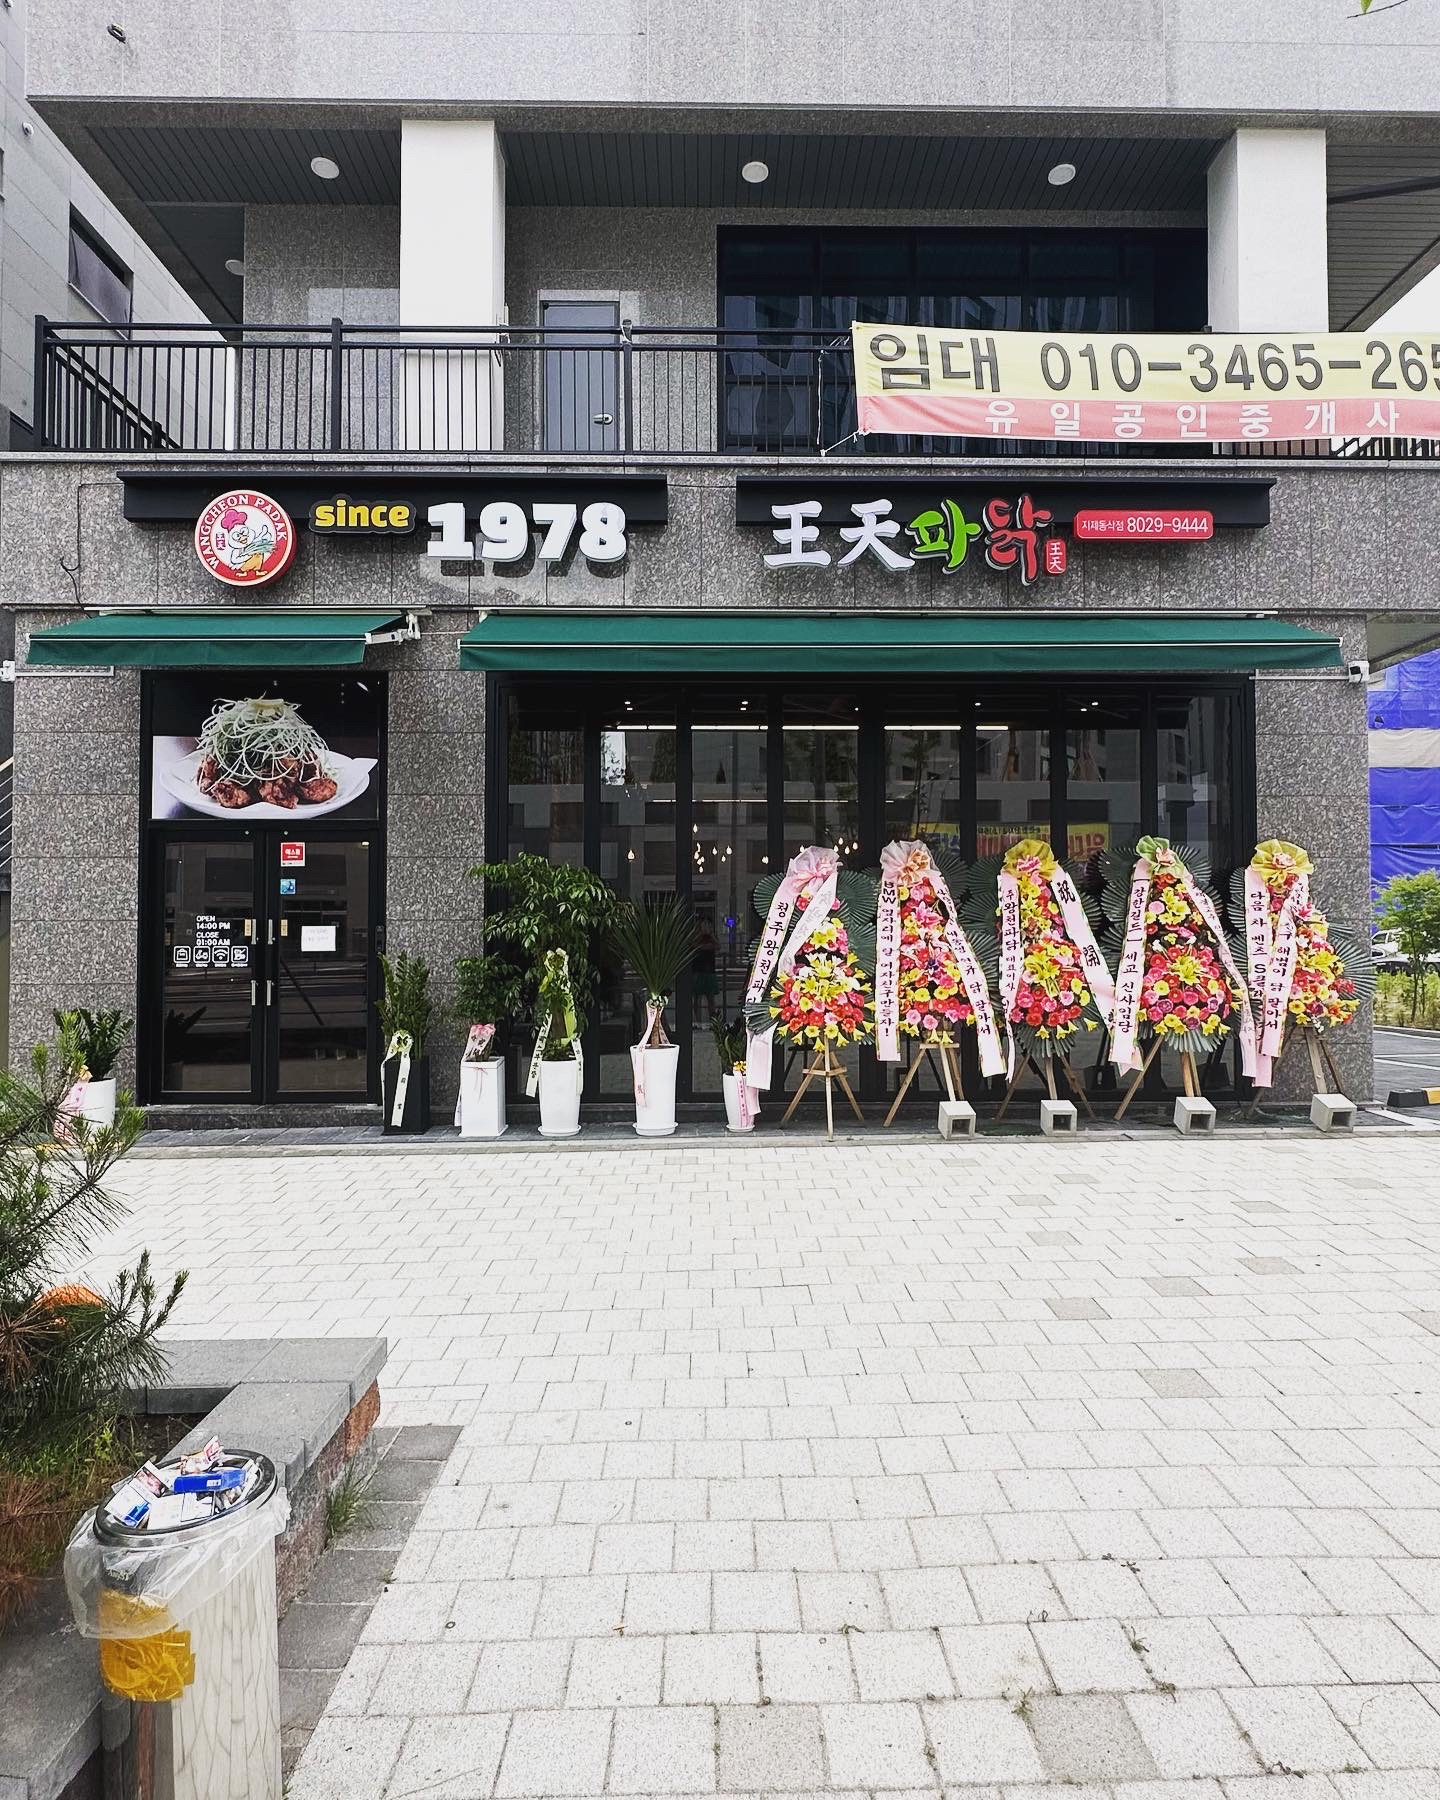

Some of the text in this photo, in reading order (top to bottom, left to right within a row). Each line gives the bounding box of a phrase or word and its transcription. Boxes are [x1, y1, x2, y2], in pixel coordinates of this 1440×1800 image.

[869, 333, 999, 393] 임대
[199, 494, 288, 570] WANGCHEON PADAK
[314, 499, 628, 562] since 1978
[1081, 516, 1208, 532] 지제동삭점 8029-9444
[882, 880, 897, 905] BMW
[1250, 891, 1266, 912] 다음
[218, 922, 231, 930] PM
[217, 938, 231, 946] AM
[1251, 934, 1268, 956] 벤츠
